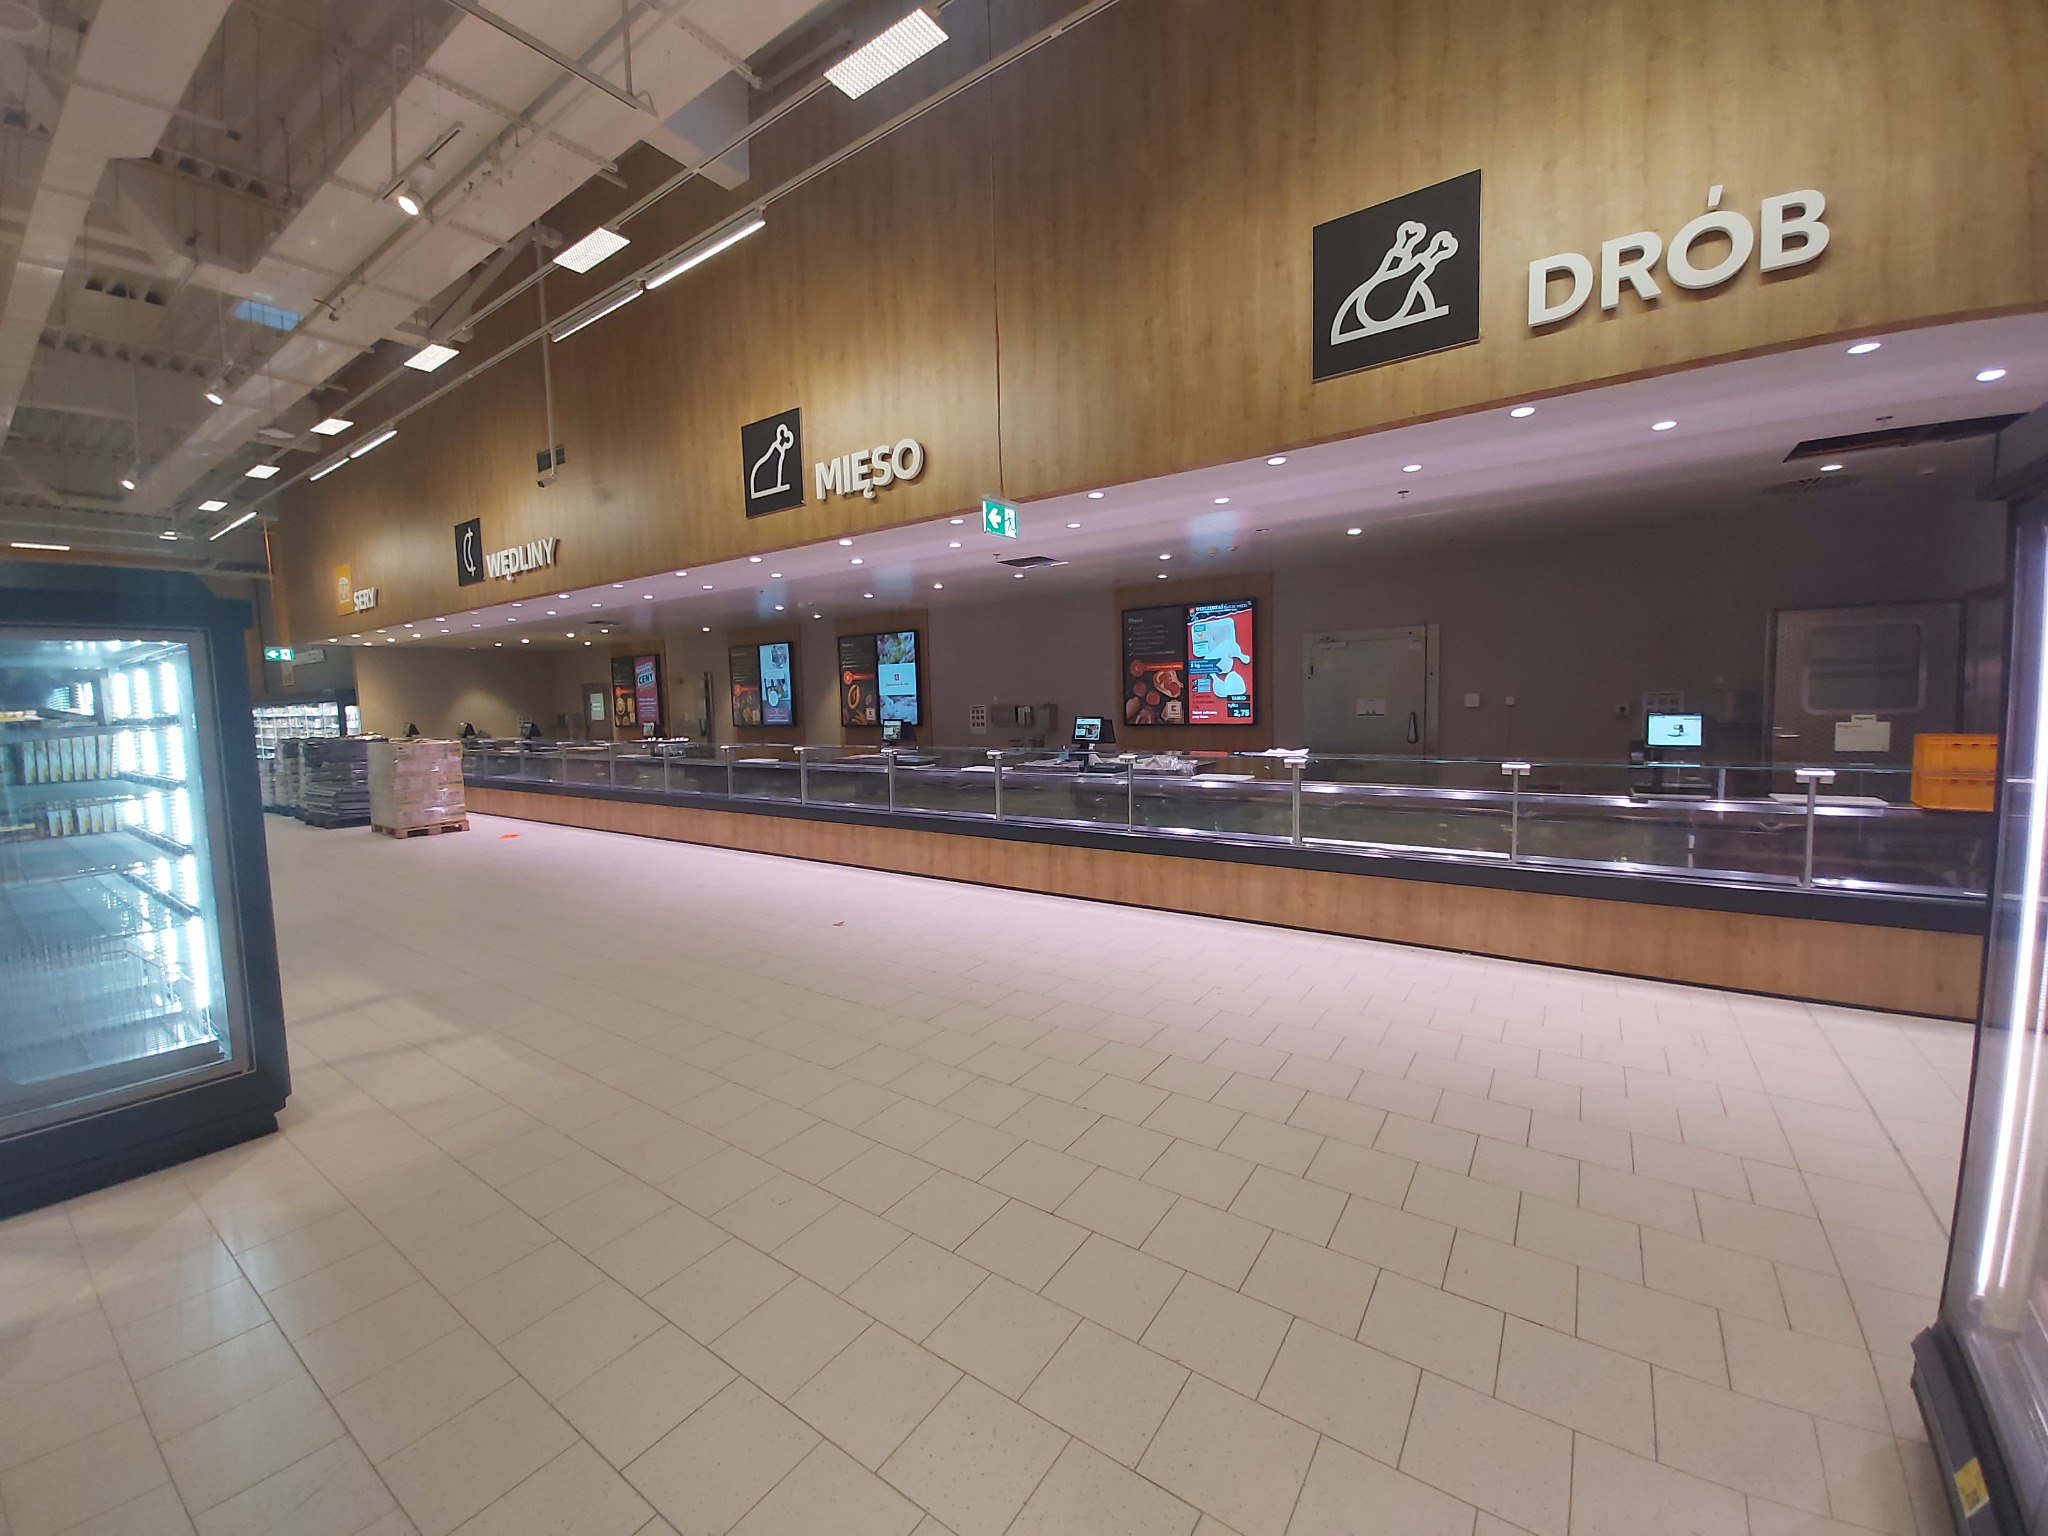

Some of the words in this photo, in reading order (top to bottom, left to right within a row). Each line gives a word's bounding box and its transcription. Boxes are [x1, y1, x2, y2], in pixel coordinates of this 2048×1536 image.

[1528, 185, 1831, 328] DRÓB
[815, 438, 925, 500] MIĘSO
[485, 537, 558, 583] WĘDLINY
[353, 587, 377, 612] SERY
[638, 672, 653, 685] CENY
[1233, 709, 1250, 718] 2,75
